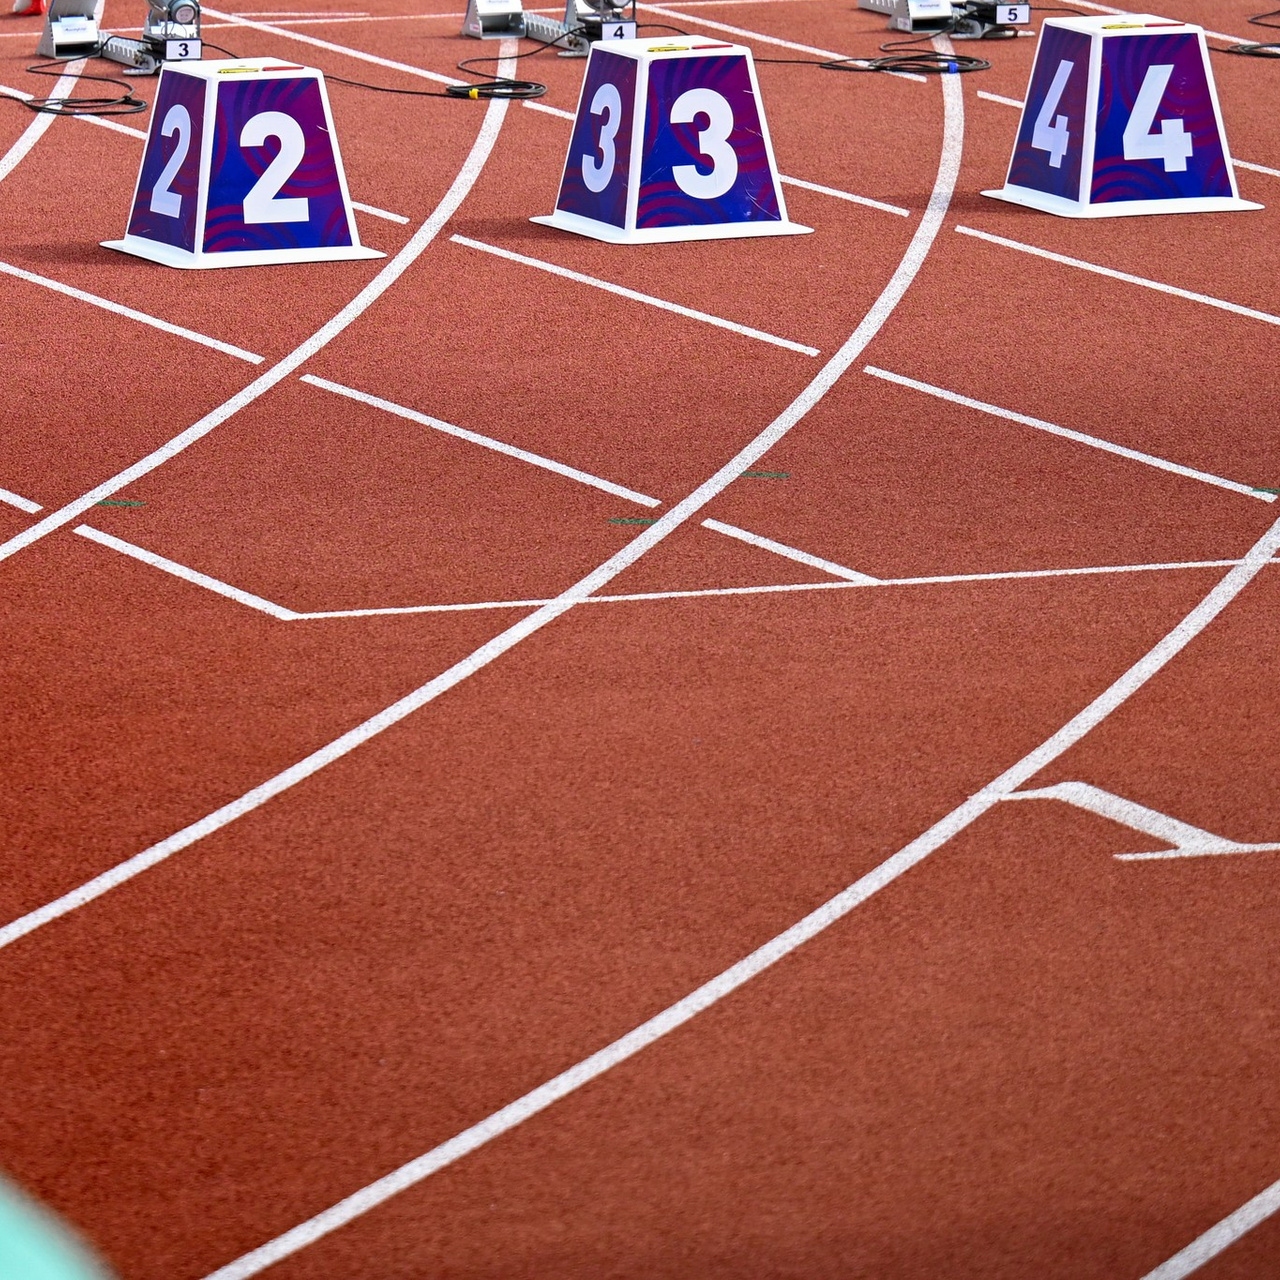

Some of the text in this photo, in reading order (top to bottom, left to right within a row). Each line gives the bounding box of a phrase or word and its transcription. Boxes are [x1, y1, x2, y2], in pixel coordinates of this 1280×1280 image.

[178, 42, 189, 58] 3
[613, 25, 625, 40] 4
[1007, 7, 1018, 22] 5
[149, 104, 191, 219] 2
[239, 111, 310, 224] 2
[581, 83, 622, 193] 3
[669, 88, 738, 200] 3
[1031, 59, 1073, 169] 4
[1122, 64, 1193, 173] 4
